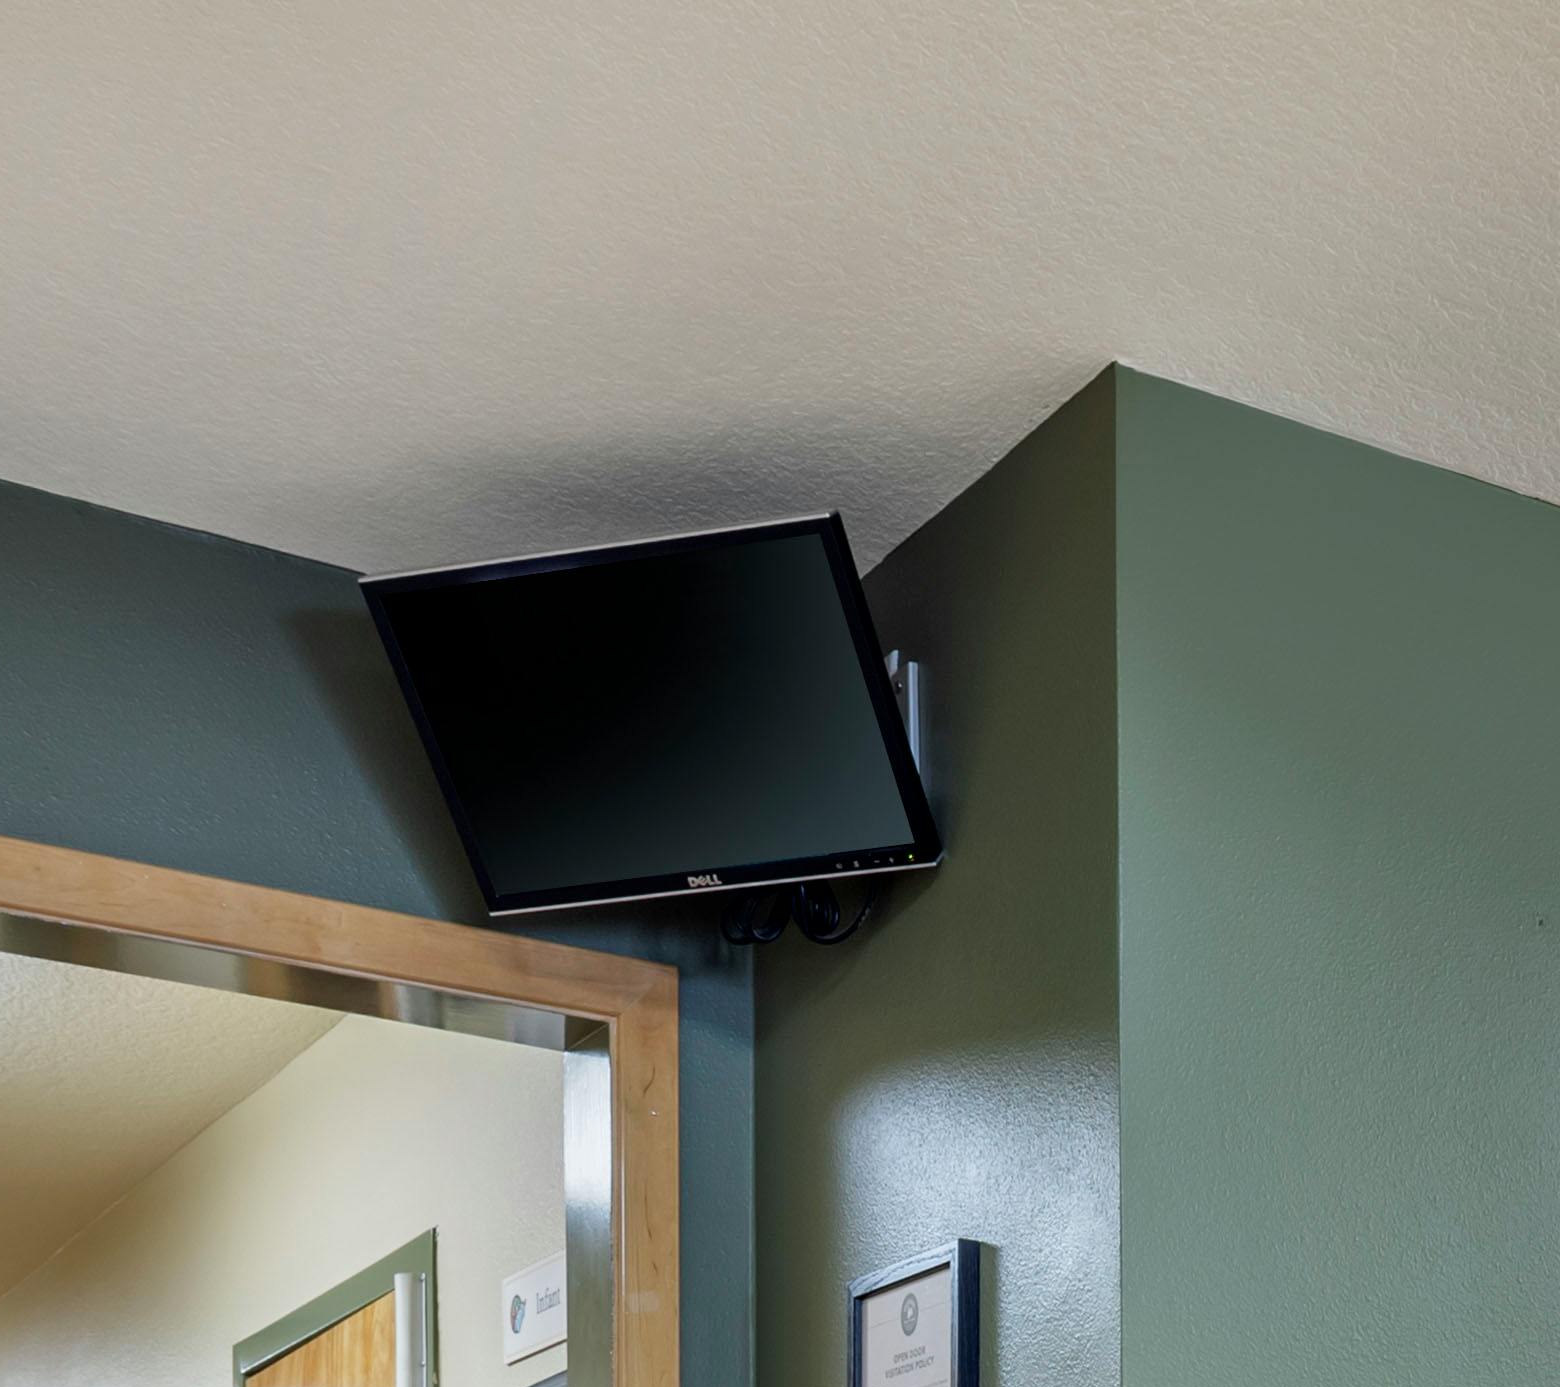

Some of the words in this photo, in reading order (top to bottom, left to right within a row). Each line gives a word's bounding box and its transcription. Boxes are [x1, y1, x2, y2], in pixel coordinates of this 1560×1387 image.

[687, 873, 723, 888] DELL
[536, 1287, 560, 1314] Infant
[893, 1351, 909, 1364] OPEN
[910, 1345, 926, 1359] DOOR
[915, 1355, 935, 1370] POLICY
